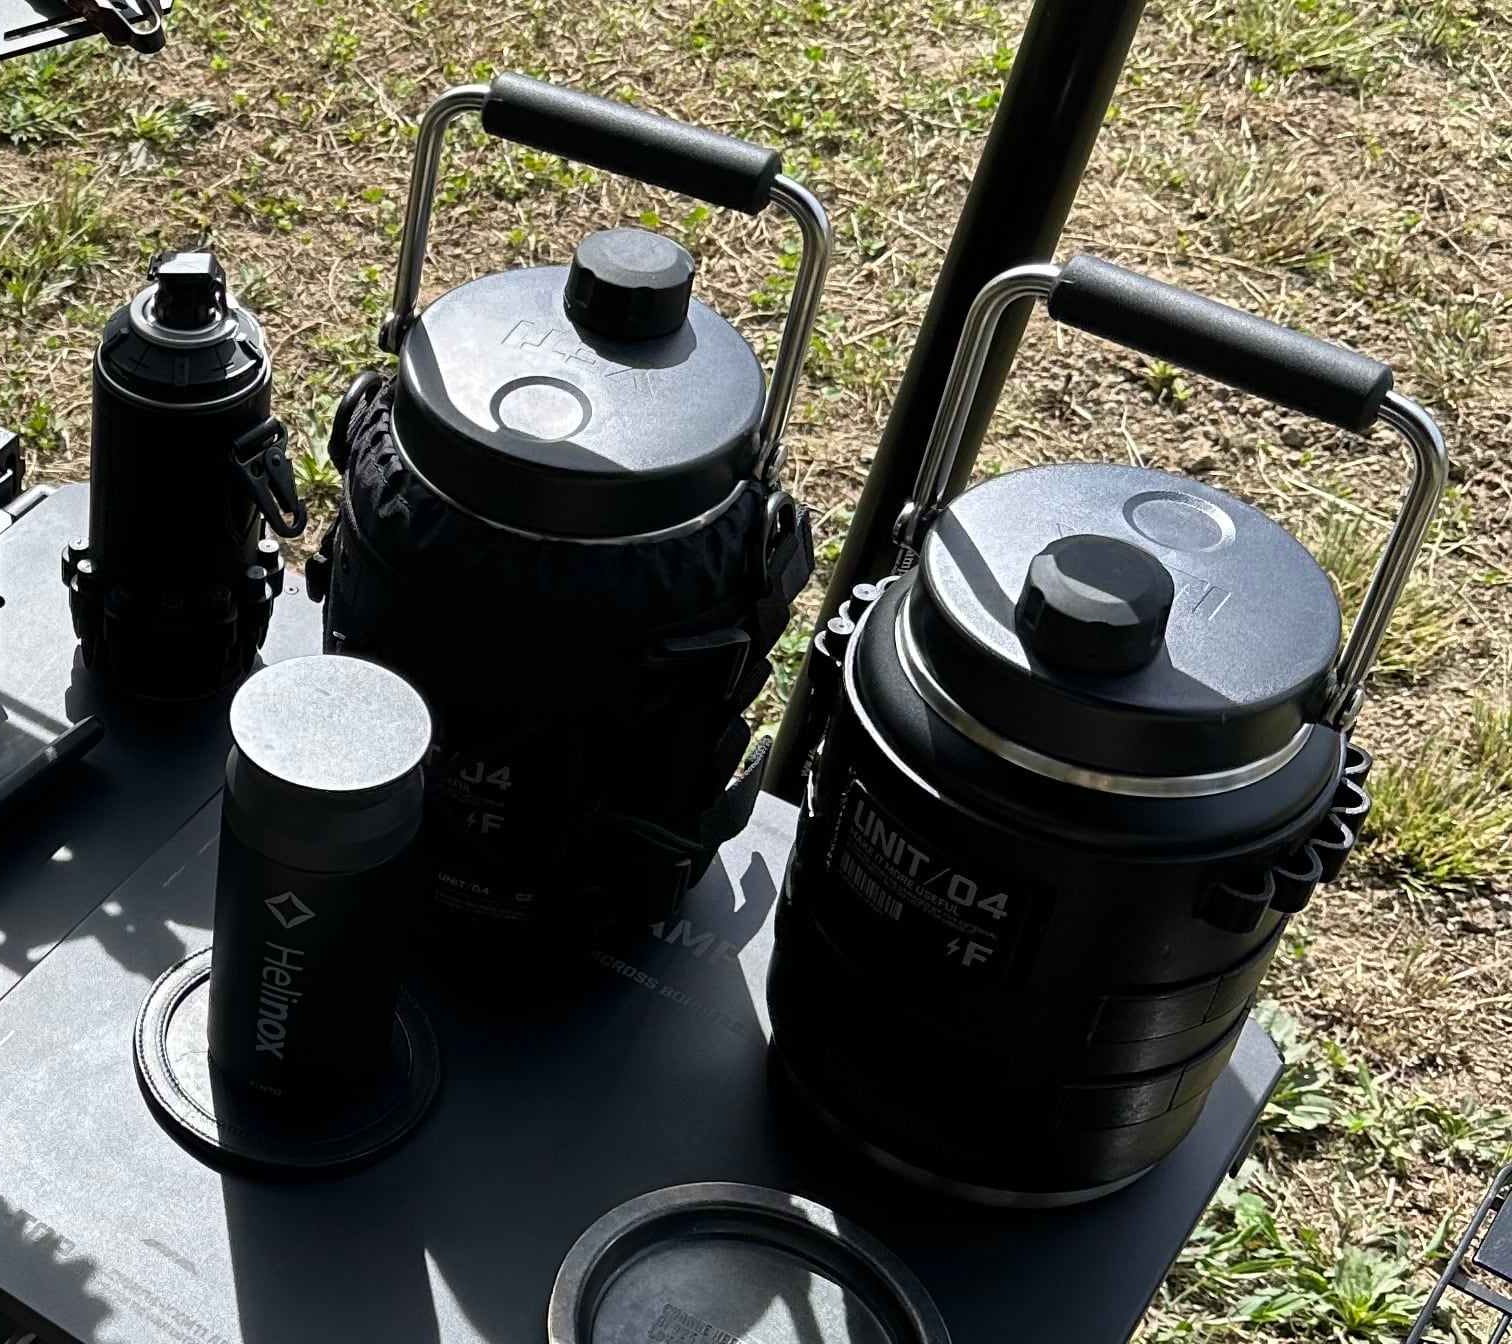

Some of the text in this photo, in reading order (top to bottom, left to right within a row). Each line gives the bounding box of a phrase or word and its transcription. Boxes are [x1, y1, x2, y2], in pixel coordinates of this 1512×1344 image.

[885, 862, 915, 889] MORE
[915, 885, 960, 917] USEFUL
[590, 949, 659, 990] ACROSS
[255, 940, 306, 1061] Helinox
